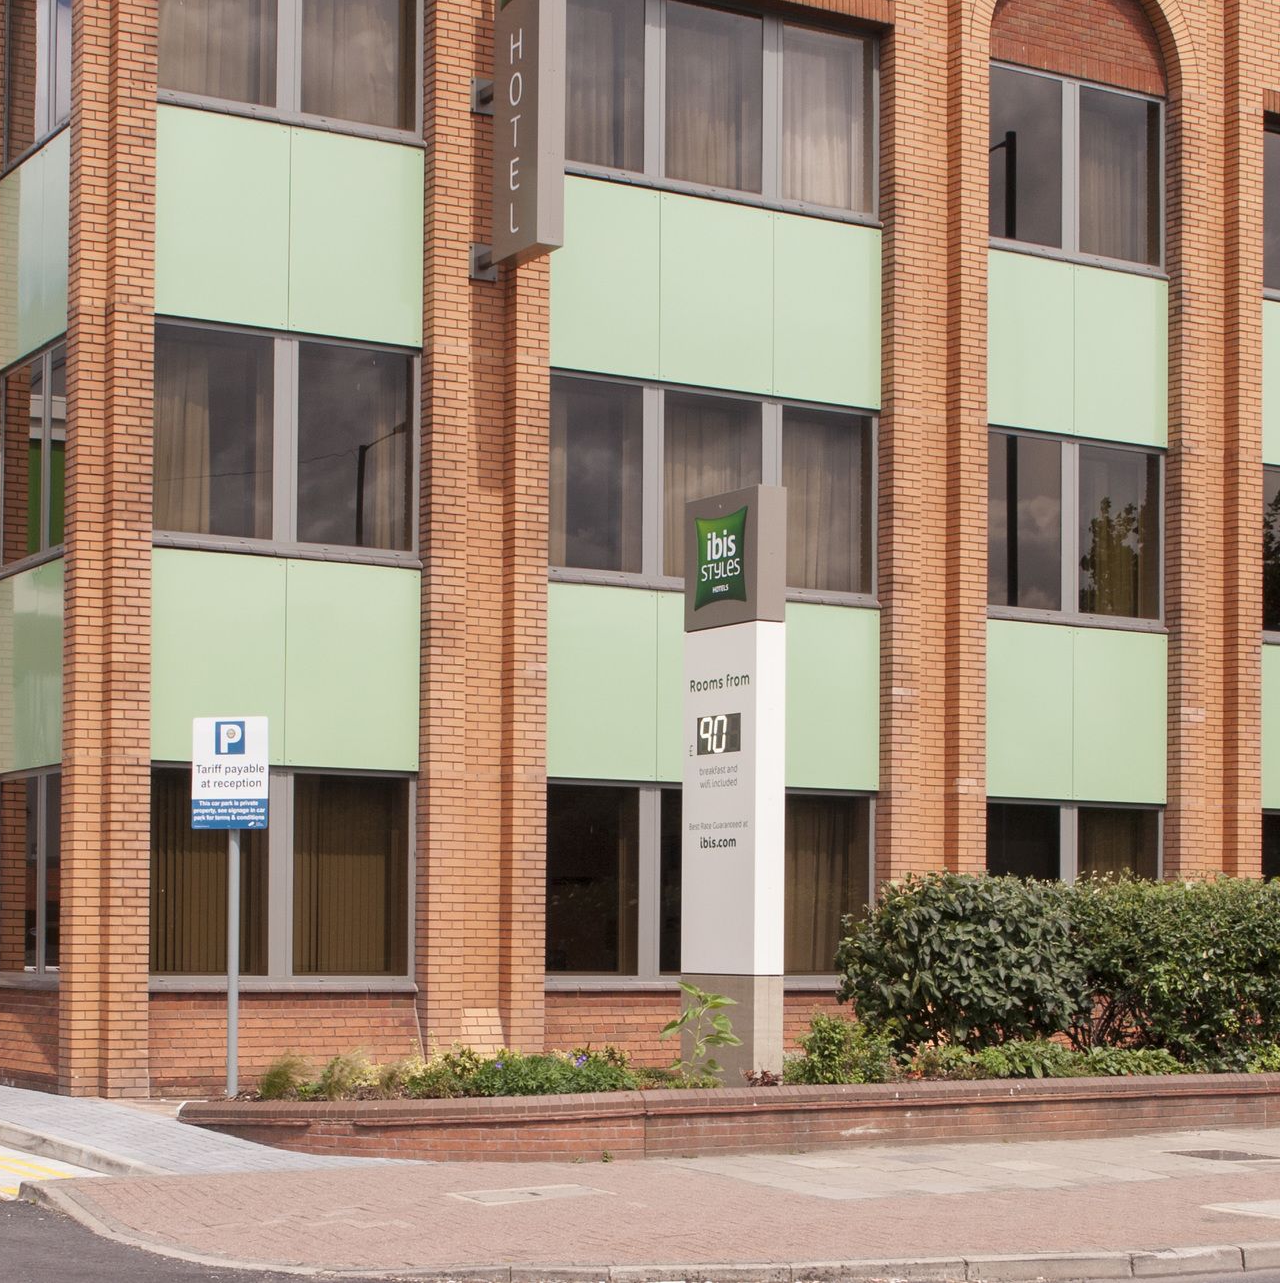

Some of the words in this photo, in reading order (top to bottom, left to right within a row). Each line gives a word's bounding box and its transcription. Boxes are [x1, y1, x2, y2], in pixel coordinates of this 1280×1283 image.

[509, 28, 523, 234] HOTEL
[706, 529, 736, 561] ibis
[712, 584, 729, 593] HOTELS
[689, 678, 723, 693] Rooms
[726, 674, 750, 688] from
[220, 724, 242, 753] P
[700, 715, 727, 754] 90
[196, 764, 222, 774] Tariff
[225, 764, 265, 776] payable
[699, 766, 726, 776] breakfast
[727, 764, 738, 773] and
[201, 779, 210, 788] at
[213, 778, 262, 789] reception
[712, 778, 737, 788] included
[700, 836, 737, 849] ibis.com
